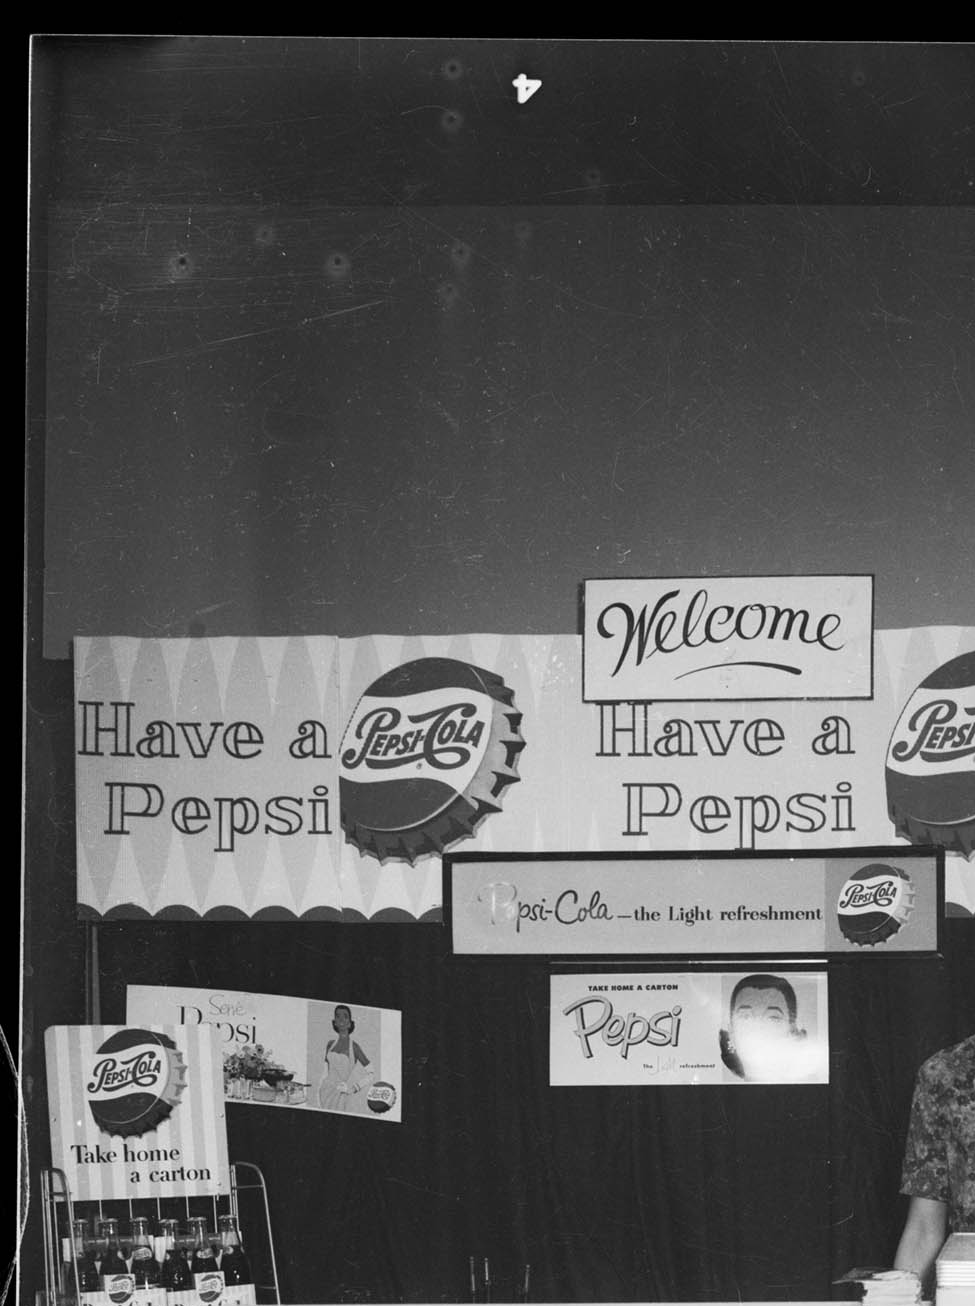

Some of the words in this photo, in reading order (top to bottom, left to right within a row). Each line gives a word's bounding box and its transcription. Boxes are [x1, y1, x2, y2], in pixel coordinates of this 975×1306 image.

[597, 589, 845, 677] Welcome
[77, 700, 263, 759] Have
[289, 718, 332, 758] a
[595, 702, 785, 758] Have
[812, 716, 855, 755] a
[103, 782, 332, 852] Pepsi
[622, 782, 856, 850] Pepsi
[669, 906, 713, 926] Light
[720, 906, 823, 921] refreshment
[176, 1006, 257, 1044] Ppsi
[563, 995, 682, 1060] Pepsi
[71, 1145, 117, 1165] Take
[123, 1144, 180, 1162] home
[130, 1170, 140, 1183] a
[149, 1168, 211, 1182] carton
